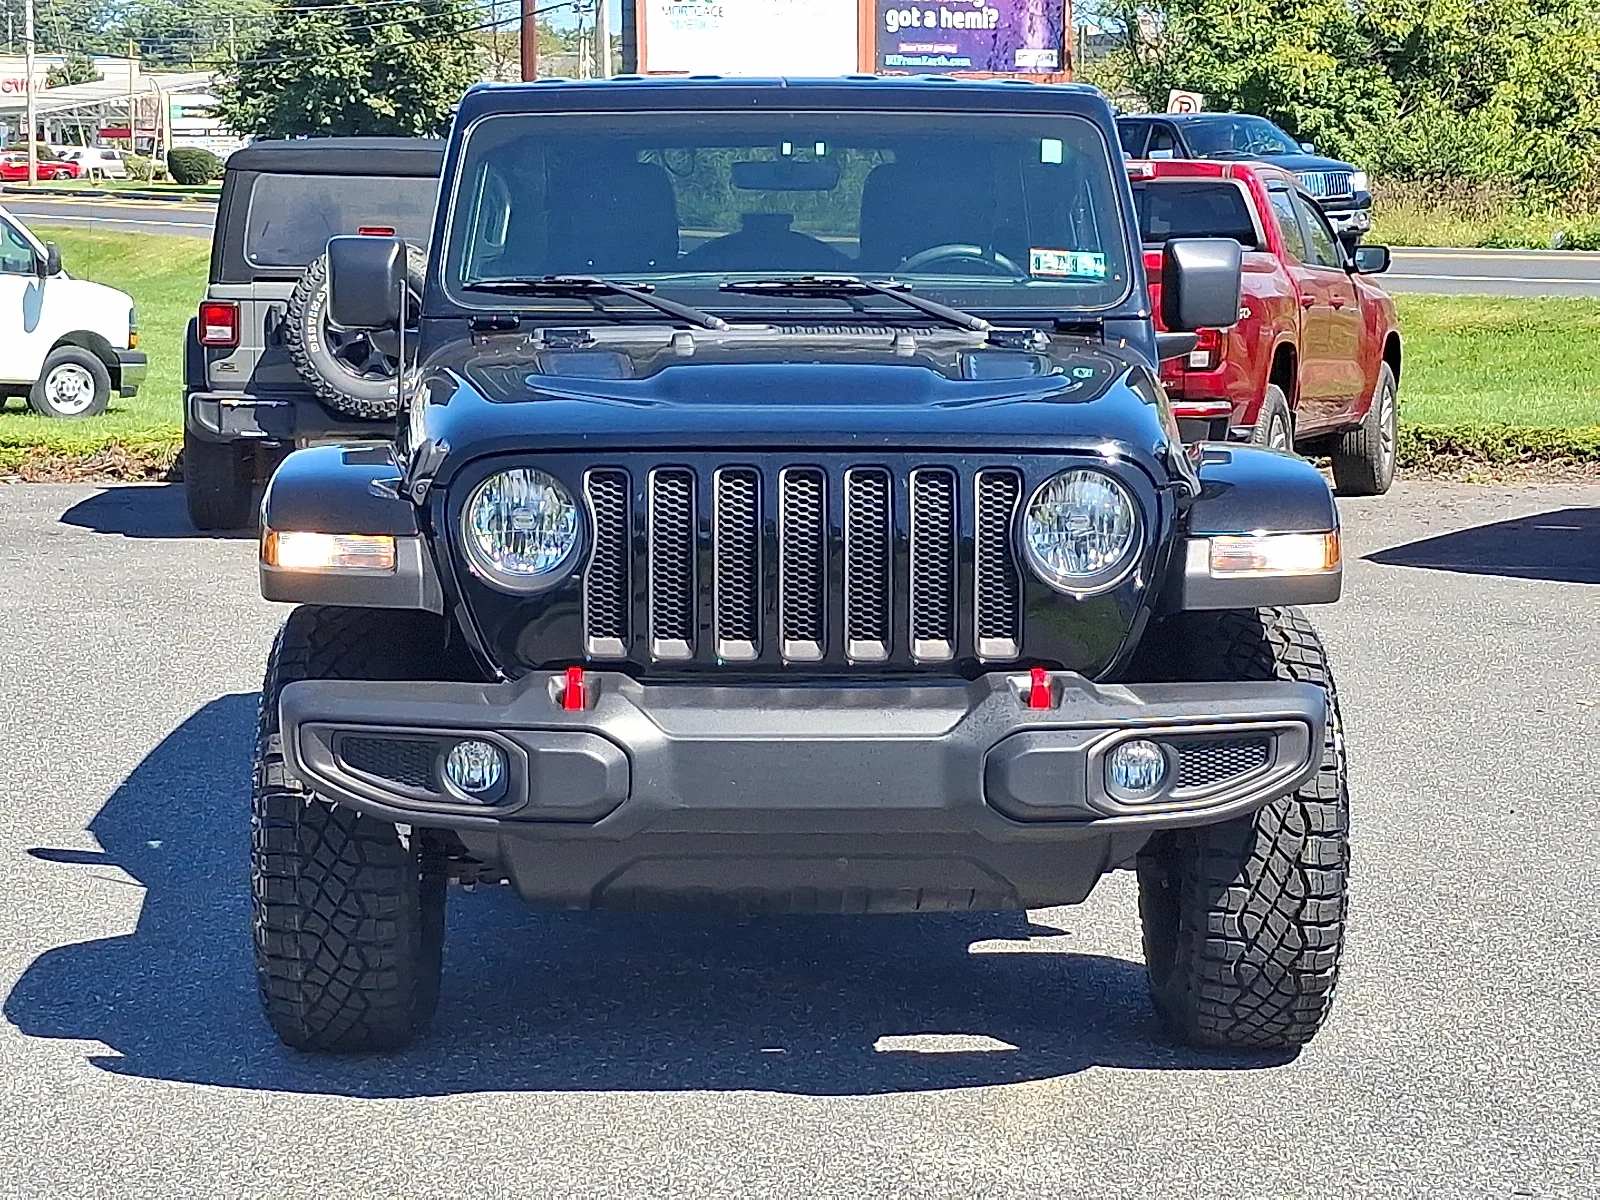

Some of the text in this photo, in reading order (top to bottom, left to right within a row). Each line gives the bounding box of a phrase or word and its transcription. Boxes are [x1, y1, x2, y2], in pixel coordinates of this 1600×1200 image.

[885, 6, 999, 33] got a hemi?
